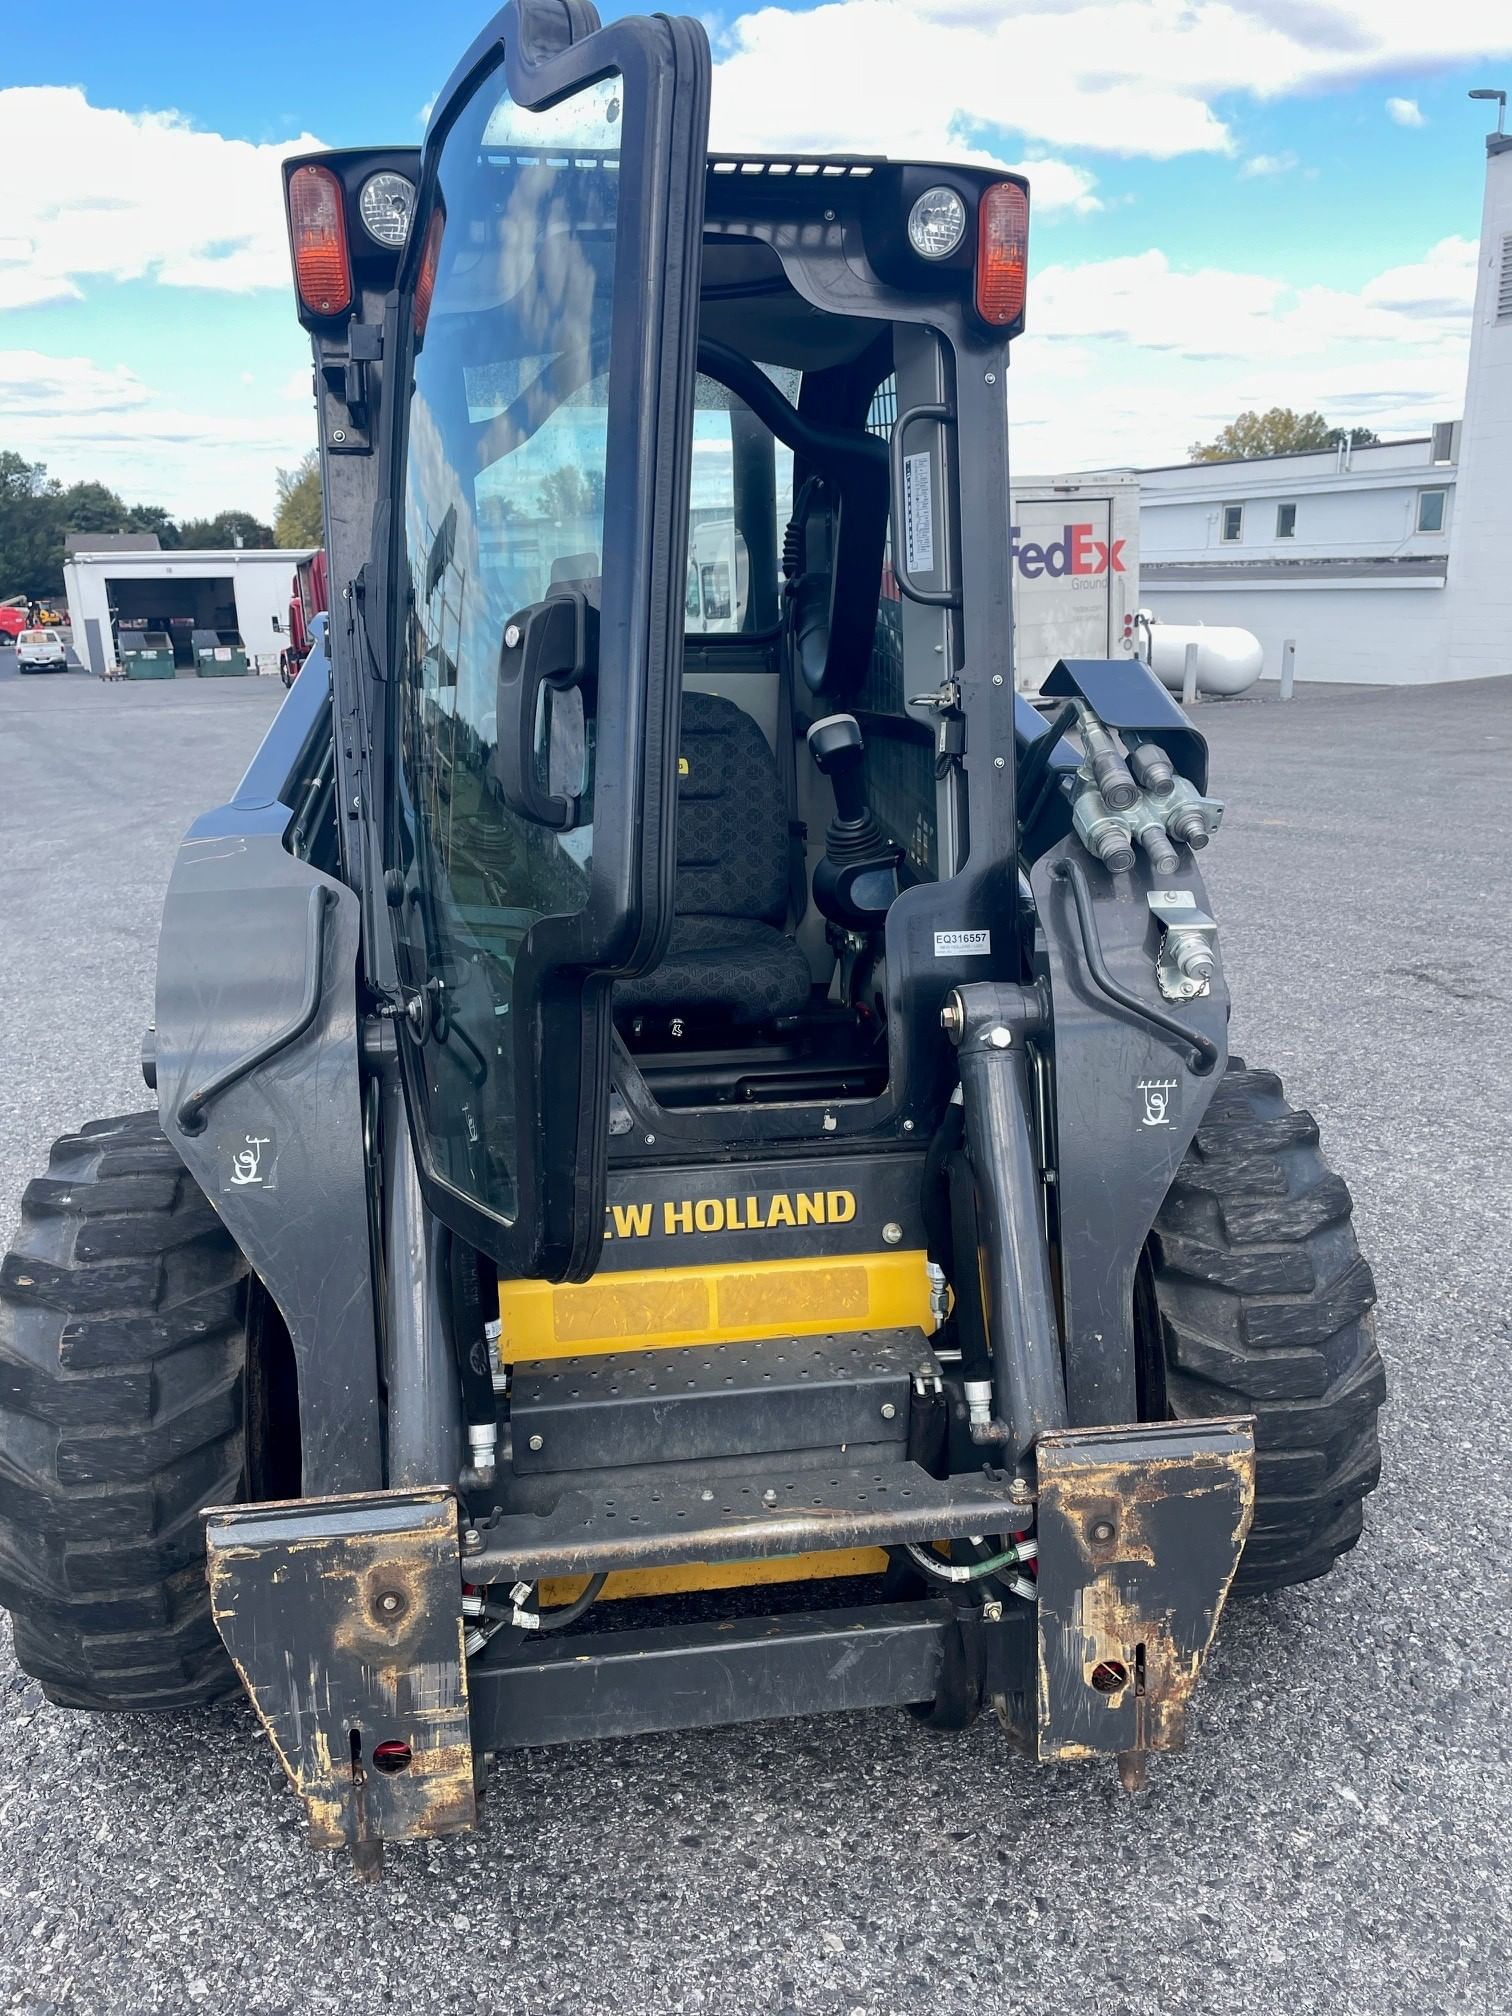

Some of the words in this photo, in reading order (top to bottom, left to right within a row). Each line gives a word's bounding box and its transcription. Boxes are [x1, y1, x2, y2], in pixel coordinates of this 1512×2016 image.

[1072, 577, 1109, 590] Ground
[936, 933, 987, 944] EQ316557
[664, 1190, 856, 1235] HOLLAND
